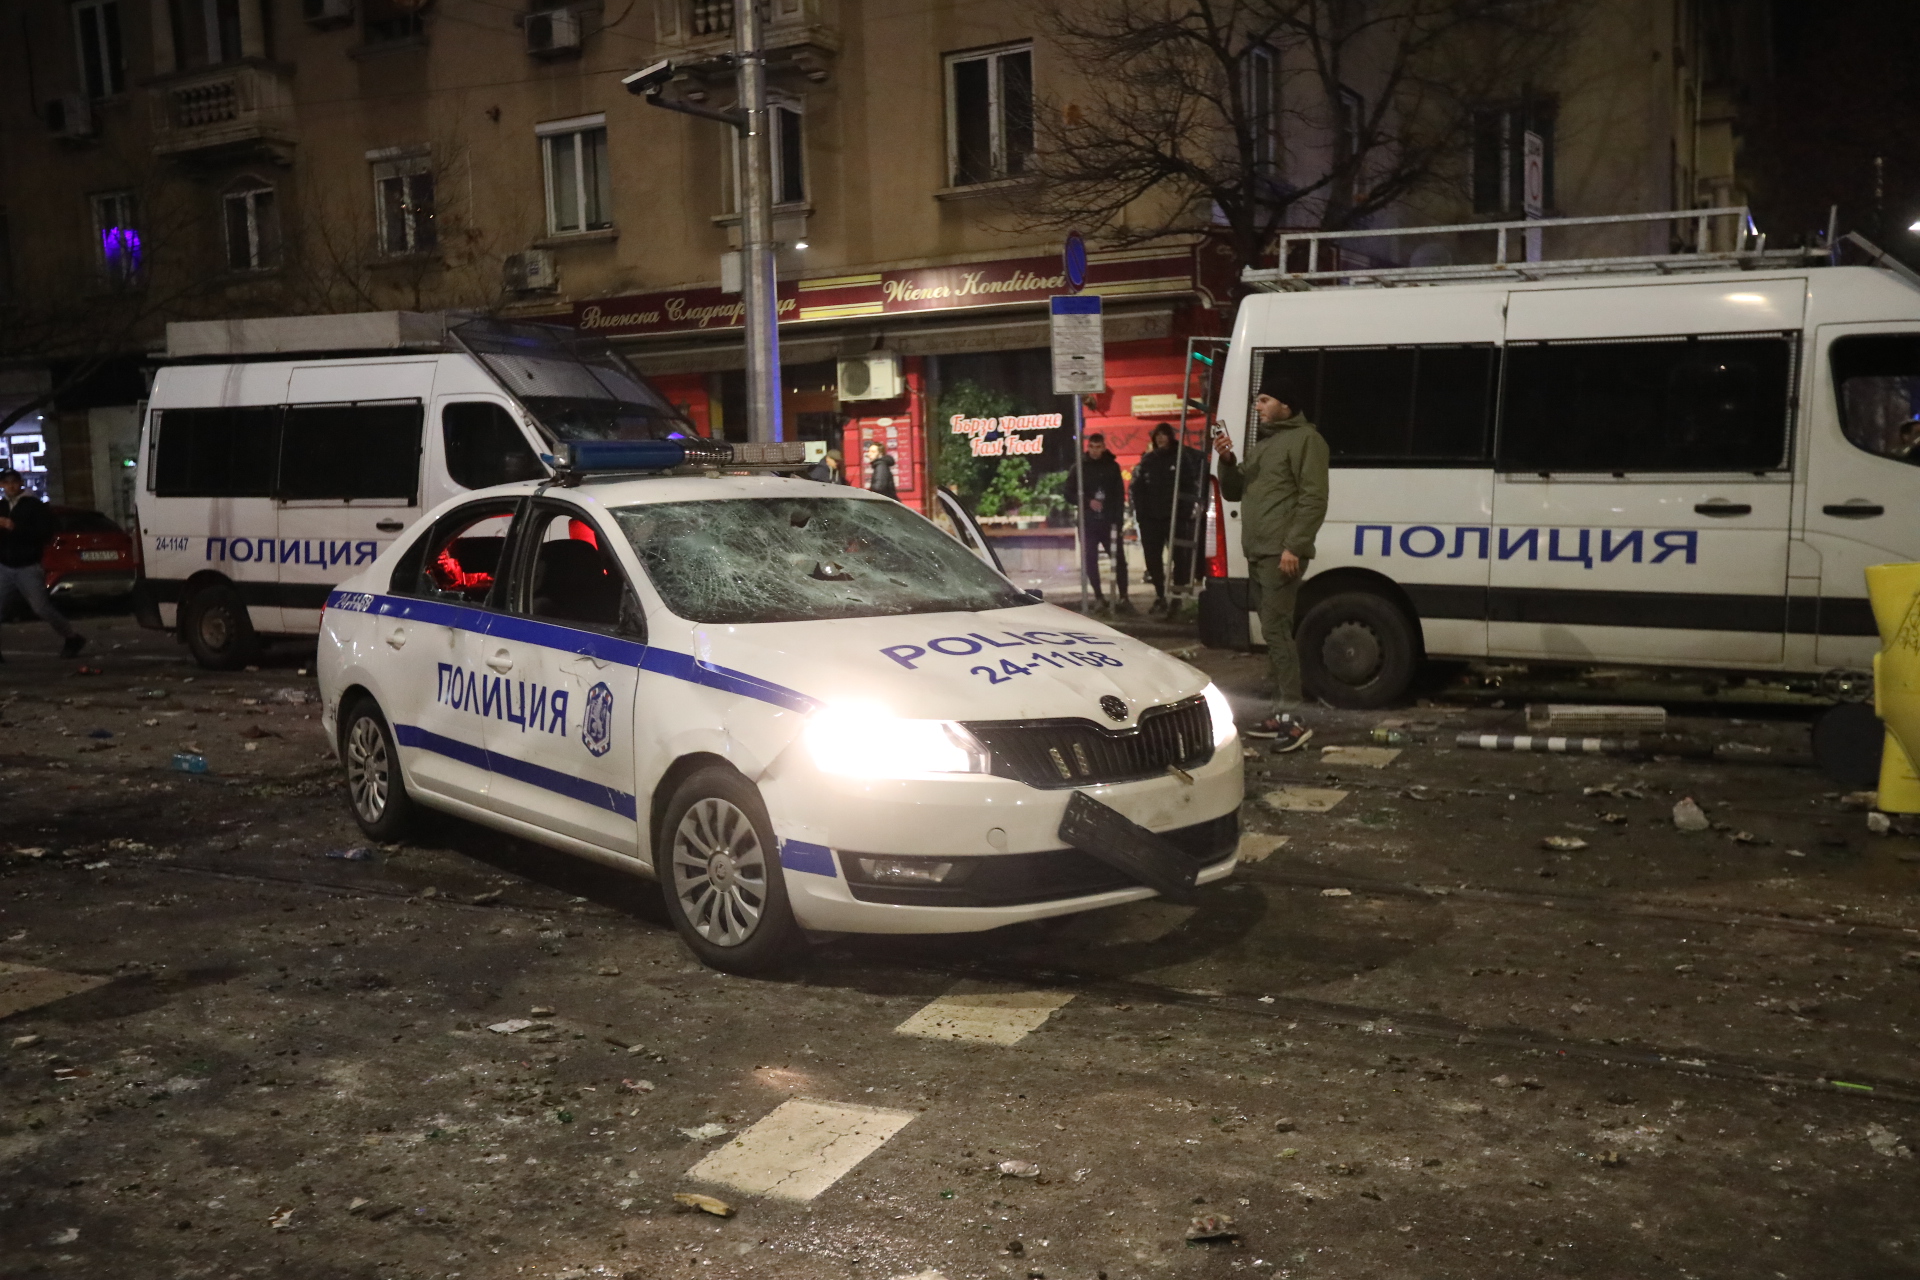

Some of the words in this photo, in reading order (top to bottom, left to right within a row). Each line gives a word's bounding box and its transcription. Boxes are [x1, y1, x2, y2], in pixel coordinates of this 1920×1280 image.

[883, 278, 951, 303] Wiener
[955, 270, 1066, 296] Konditorei
[579, 306, 660, 330] Виенска
[997, 413, 1063, 436] хранене
[970, 437, 1004, 457] Fast
[1005, 434, 1044, 456] Food
[155, 537, 188, 551] 24-1147
[206, 537, 377, 570] ПОЛИЦИЯ
[1354, 524, 1698, 569] ПОЛИЦИЯ
[879, 631, 1115, 670] POLICE
[970, 651, 1123, 685] 24-1168
[437, 662, 570, 737] ПОЛИЦИЯ
